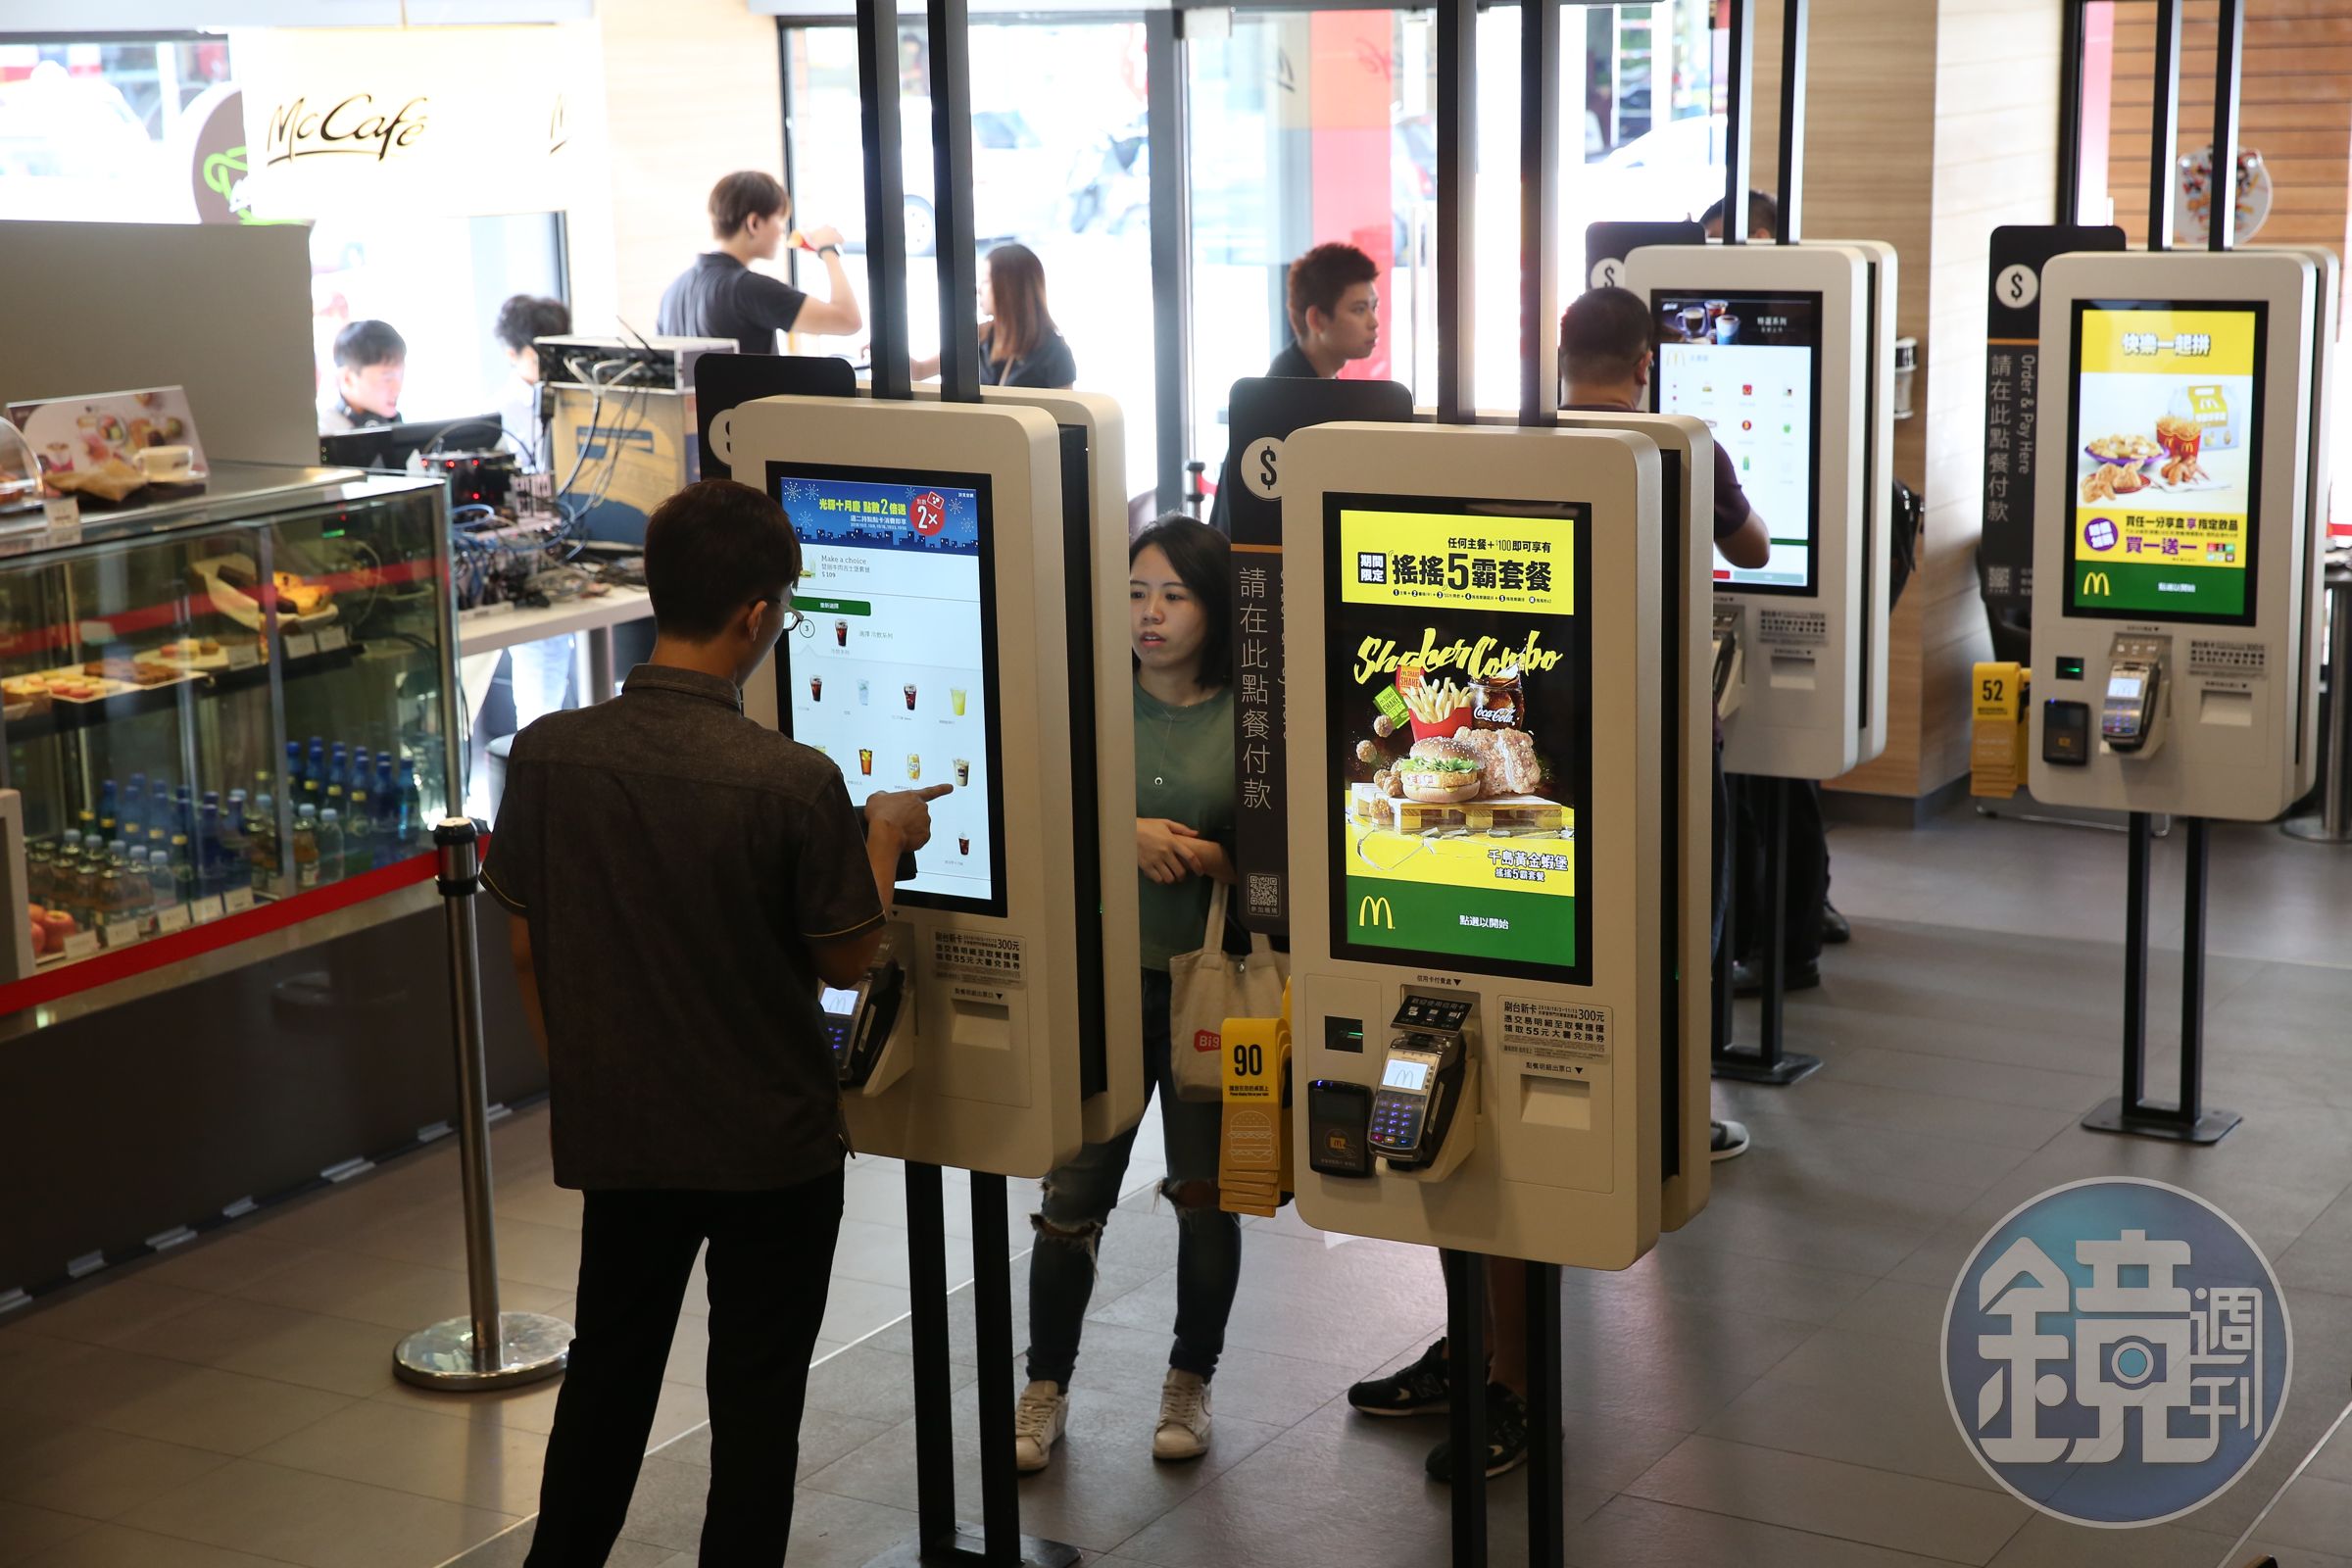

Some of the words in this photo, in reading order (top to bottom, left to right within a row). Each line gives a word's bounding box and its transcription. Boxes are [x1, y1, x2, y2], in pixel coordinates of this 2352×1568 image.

[268, 93, 428, 162] McCafé
[2020, 354, 2035, 395] Order
[1987, 355, 2012, 522] 請在此點餐付款
[2016, 412, 2034, 439] Pay
[2018, 443, 2034, 475] Here
[2126, 536, 2197, 556] 買一送一
[821, 555, 839, 564] Make
[845, 557, 867, 565] choice
[1239, 567, 1272, 809] 請在此點餐付款
[1983, 679, 2003, 702] 52
[1487, 849, 1569, 872] 千島黃金蝦堡
[1459, 914, 1509, 931] 點選以開始
[1578, 1008, 1605, 1022] 300元
[1234, 1044, 1263, 1076] 90
